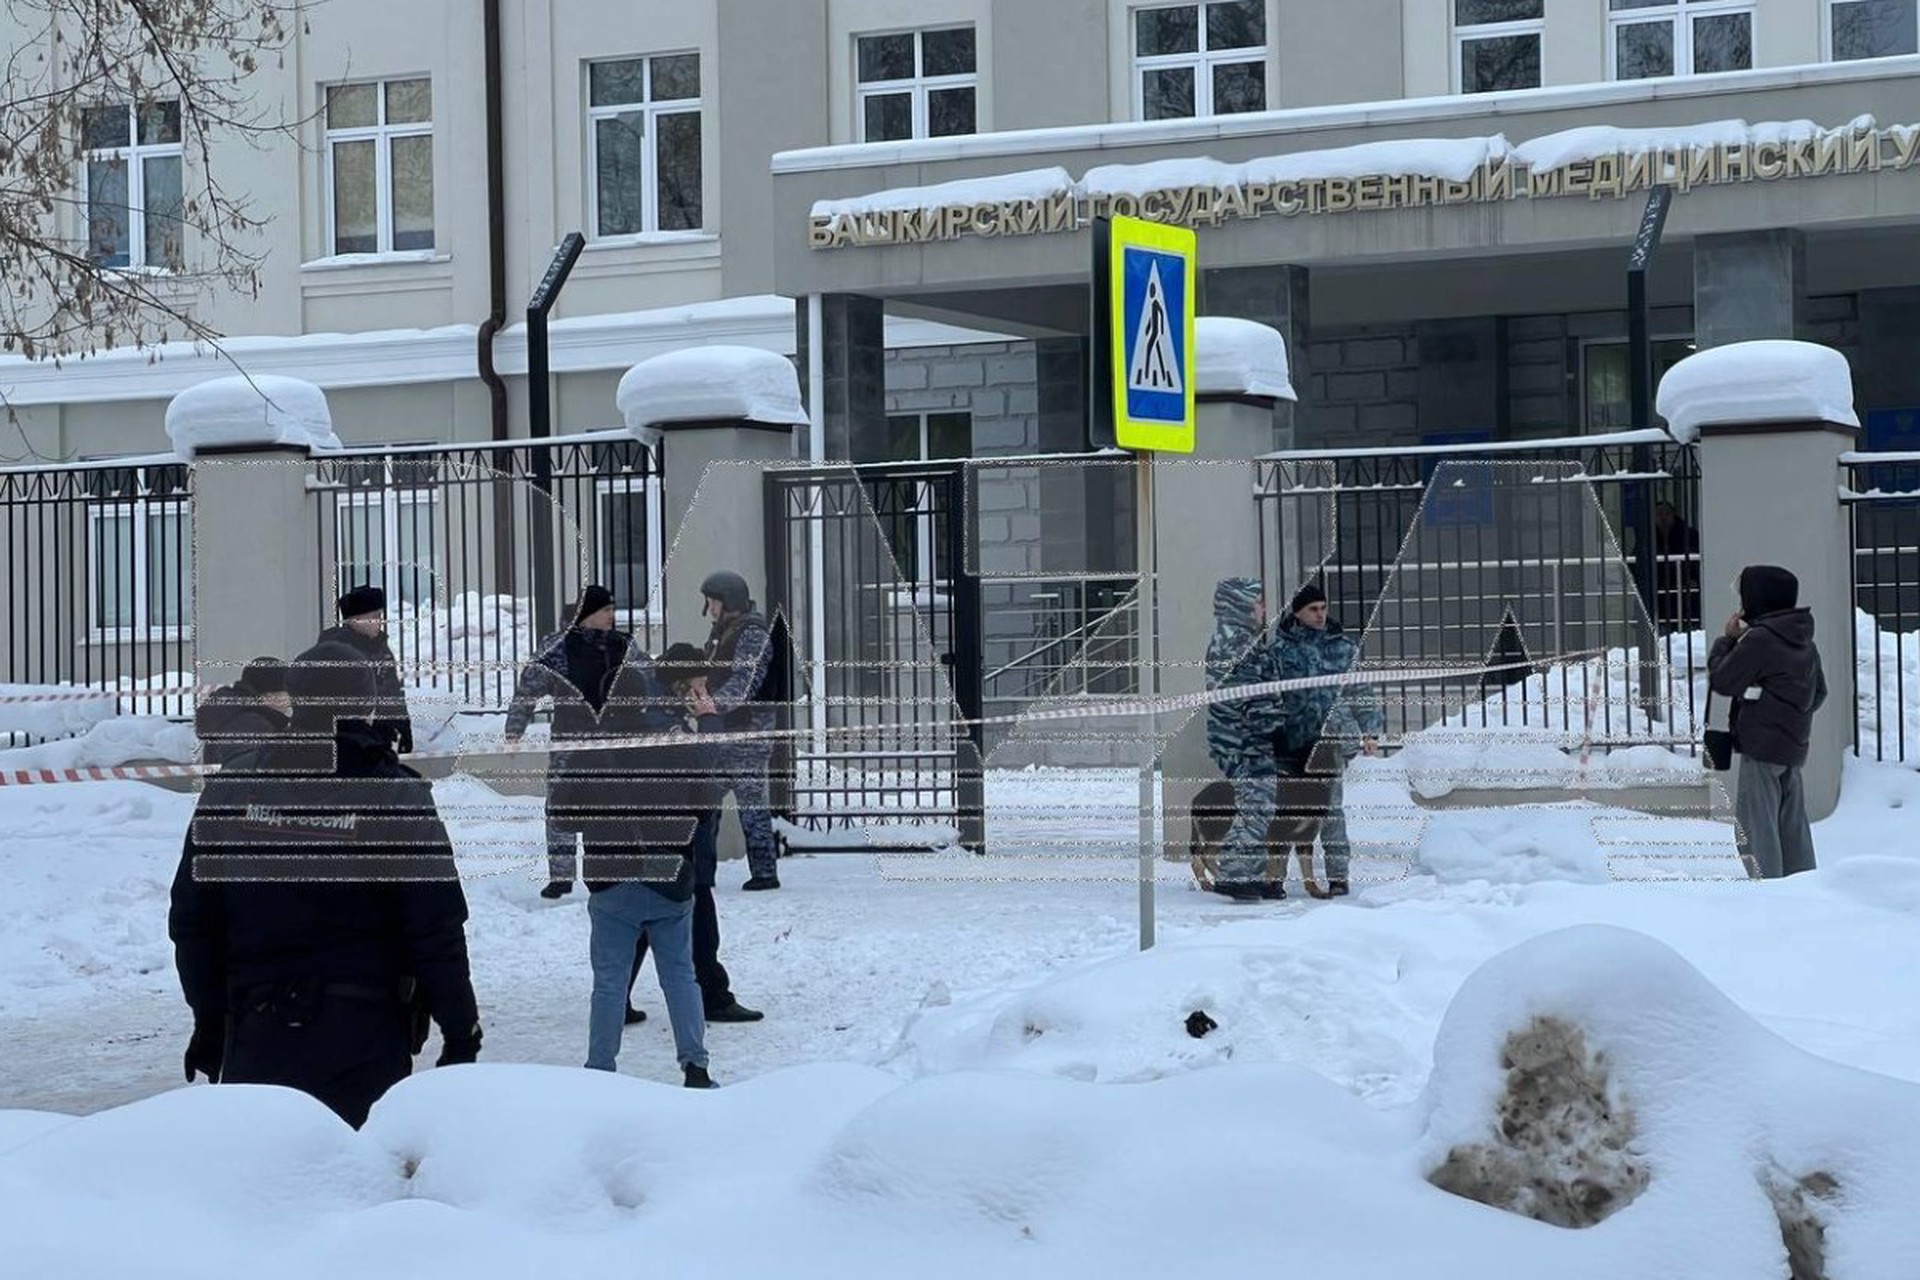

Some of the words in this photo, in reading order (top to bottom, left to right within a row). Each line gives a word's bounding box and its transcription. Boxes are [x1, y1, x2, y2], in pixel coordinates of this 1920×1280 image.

[808, 190, 1079, 250] БАШКИРСКИЙ
[1087, 157, 1515, 227] ГОСУДАРСТВЕННЫЙ
[1527, 125, 1882, 201] МЕДИЦИНСКИЙ
